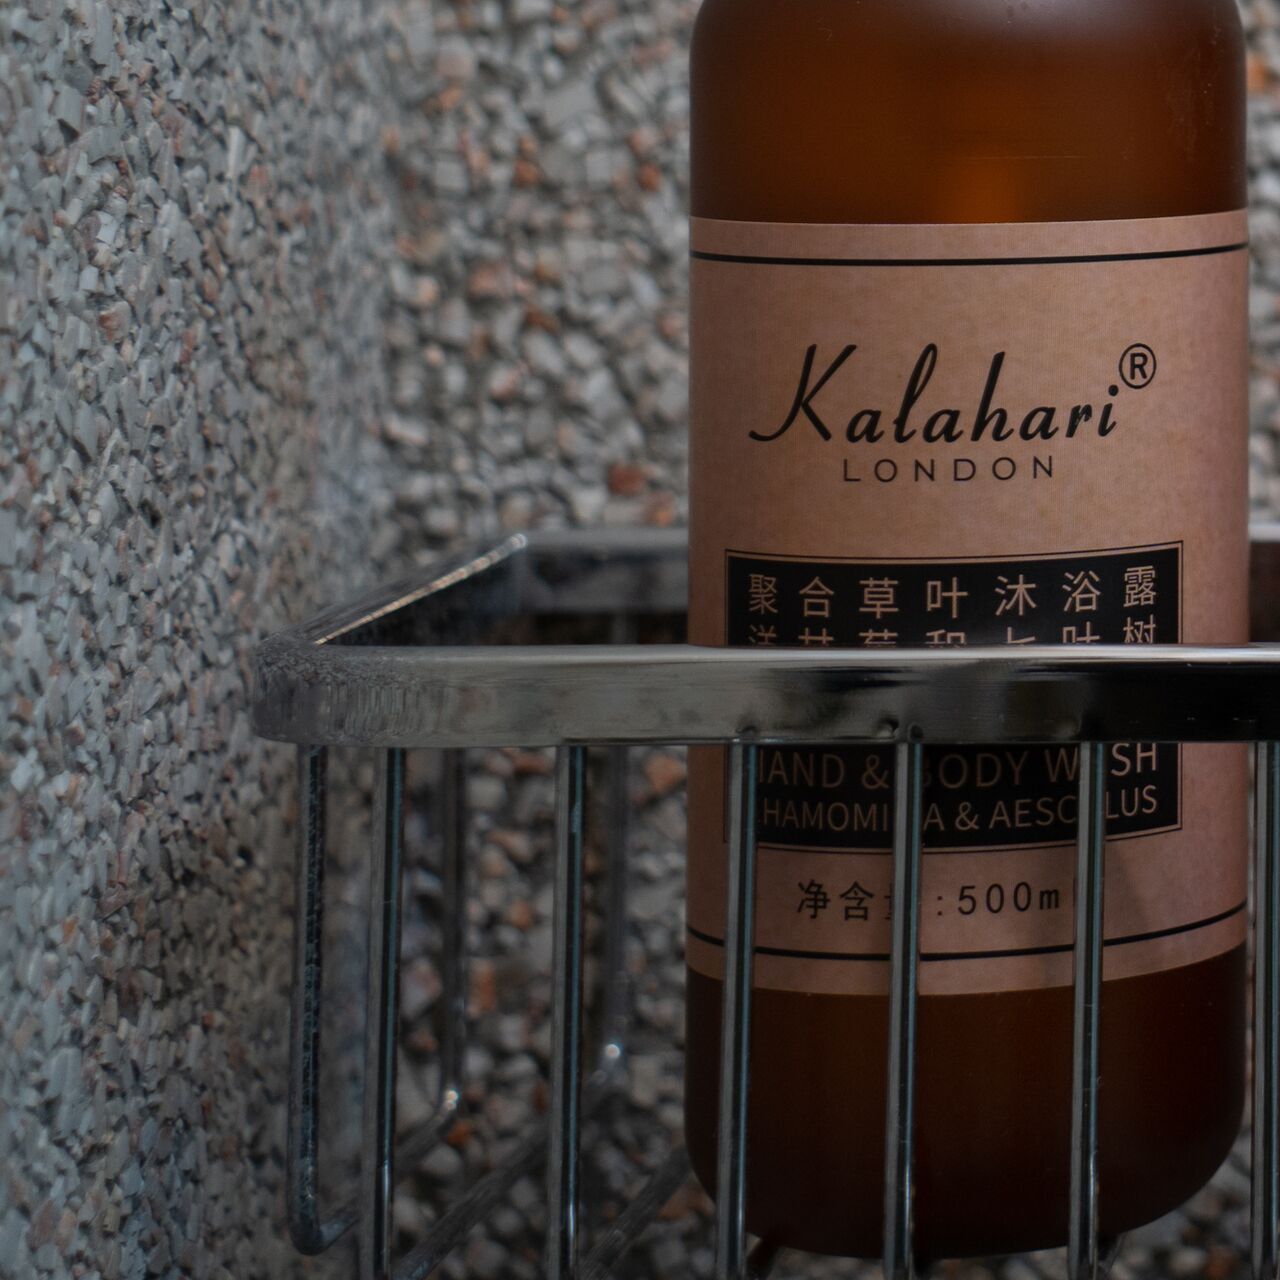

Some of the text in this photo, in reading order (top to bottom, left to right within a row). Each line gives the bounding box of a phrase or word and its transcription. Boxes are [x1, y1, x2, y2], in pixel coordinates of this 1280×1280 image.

[843, 455, 1054, 483] LONDON
[748, 565, 1158, 619] 聚合草叶沐浴露
[758, 750, 846, 789] AND
[861, 753, 889, 790] &
[1044, 742, 1158, 783] WSH
[759, 785, 1158, 832] HAMOMIA & AESCLUS
